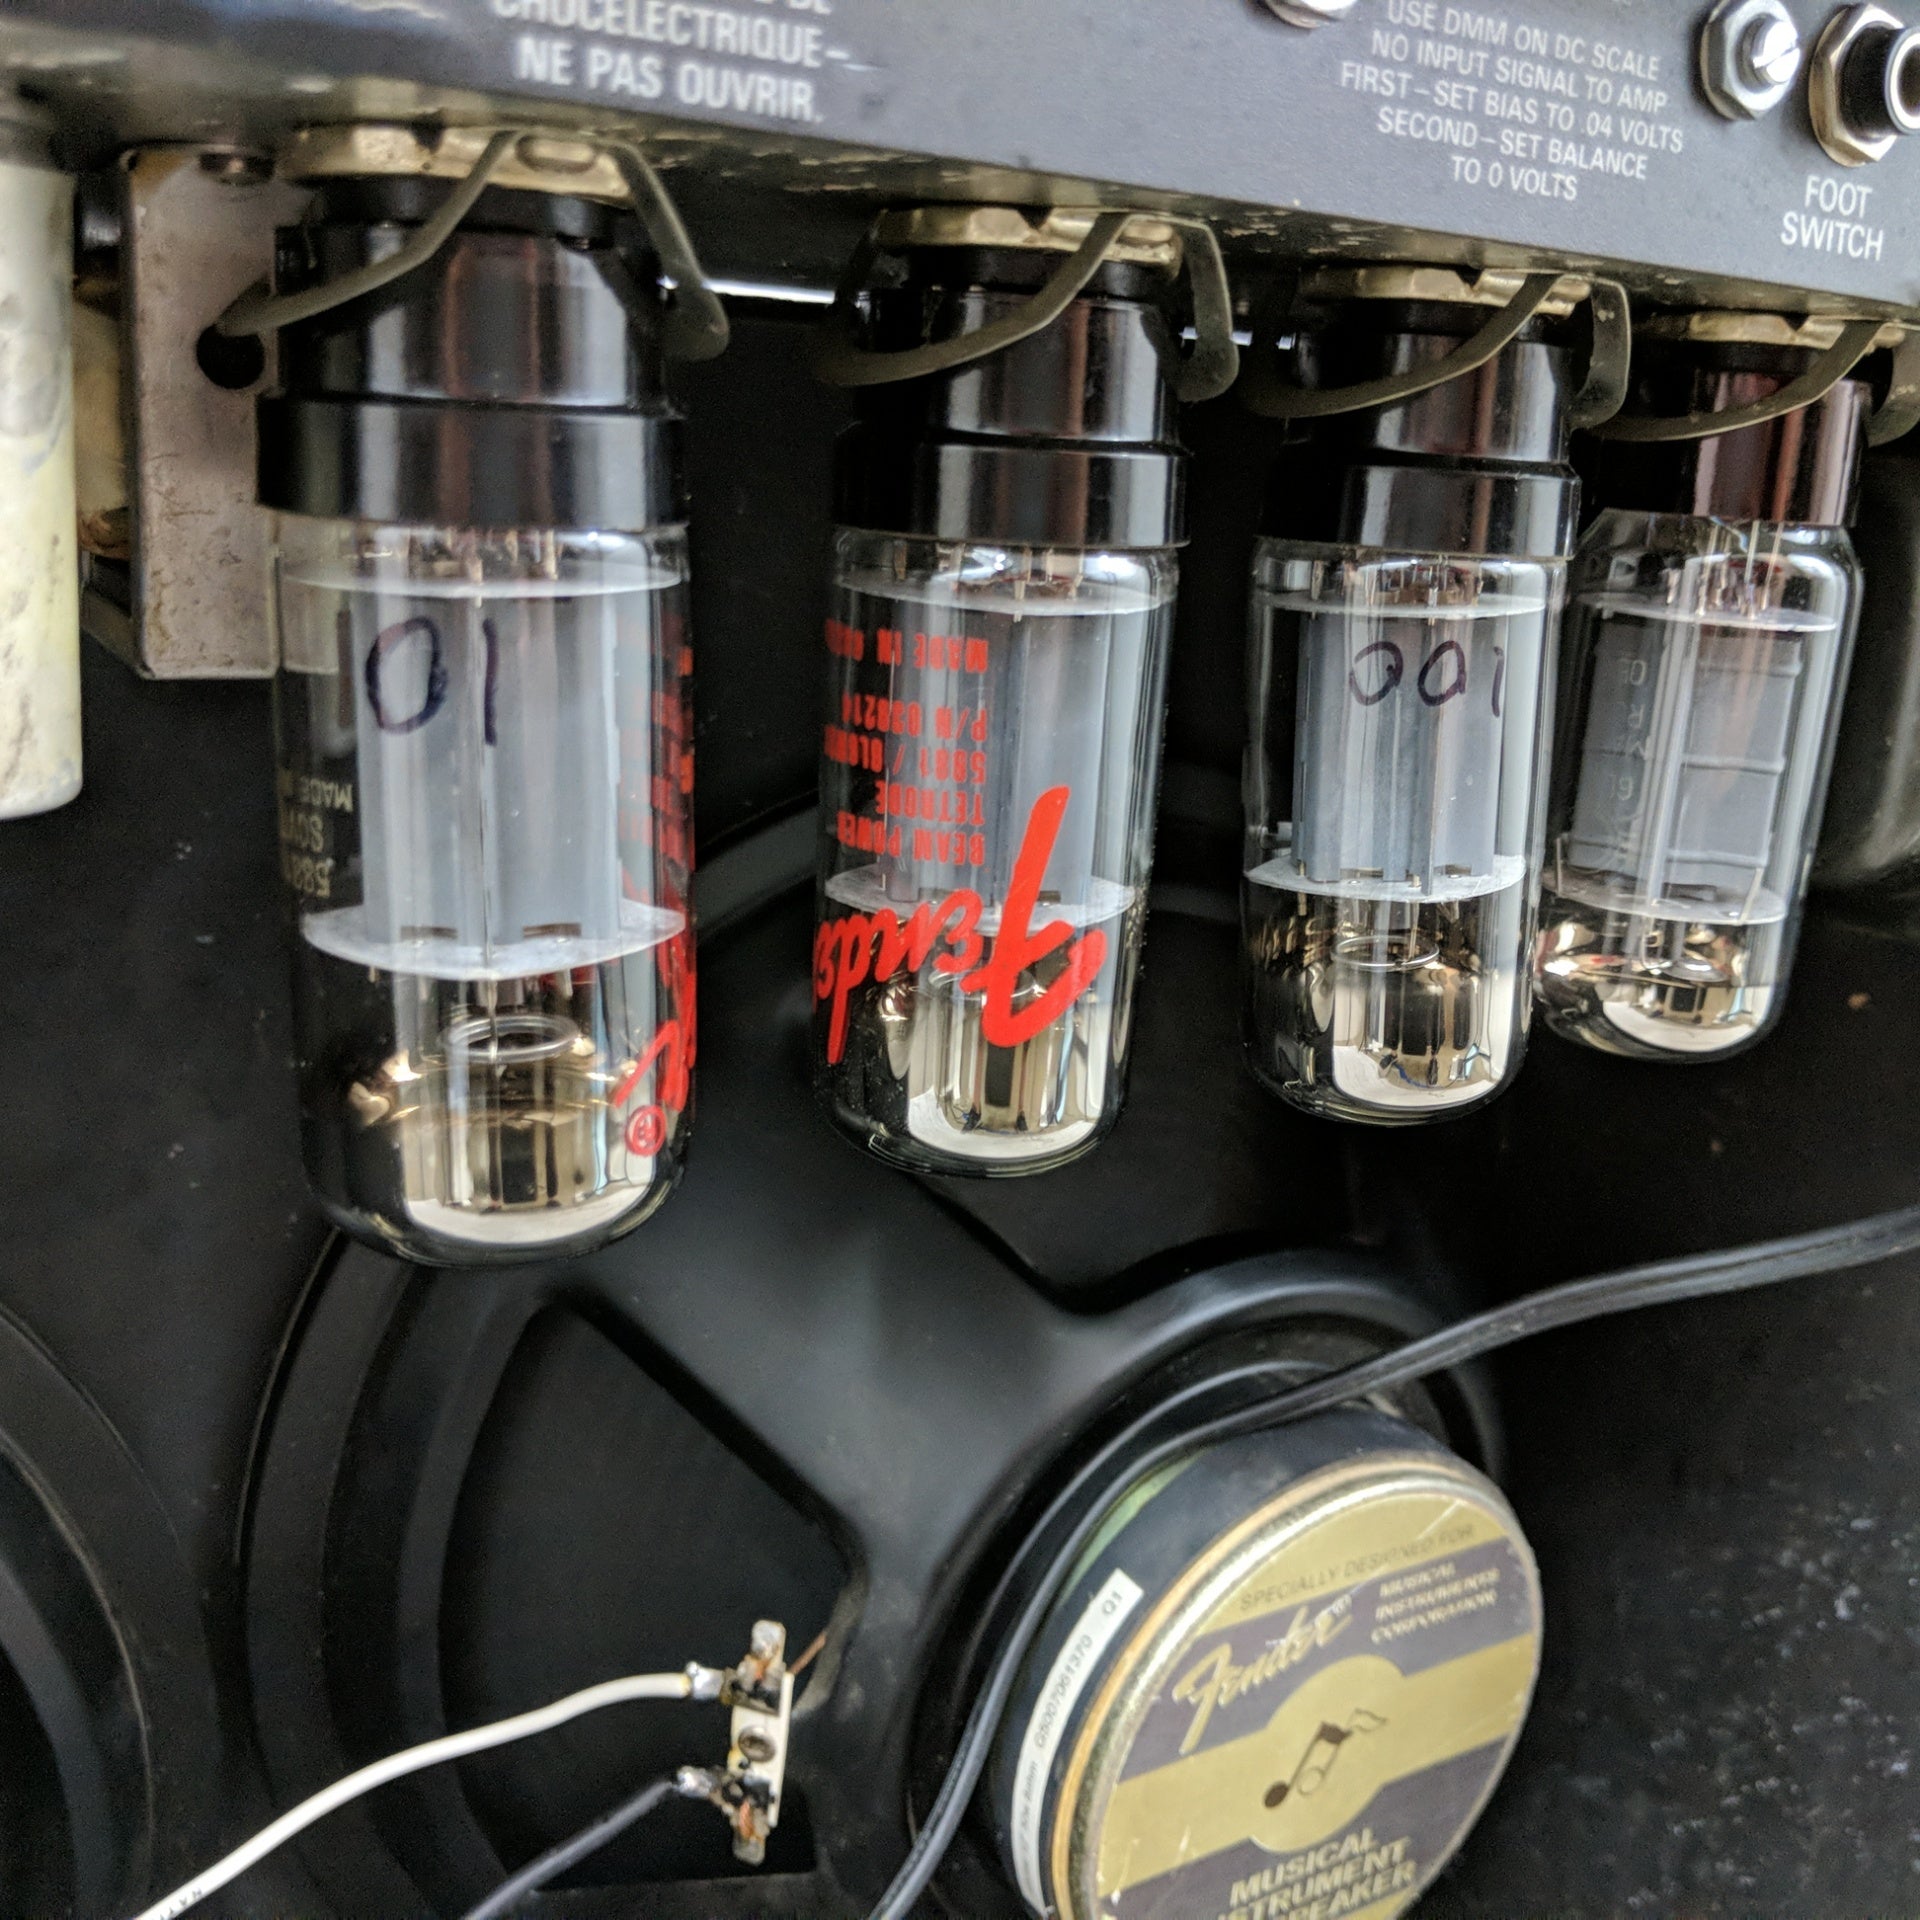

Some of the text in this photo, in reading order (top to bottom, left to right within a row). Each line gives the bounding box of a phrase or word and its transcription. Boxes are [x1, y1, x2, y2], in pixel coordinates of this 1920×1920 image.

[1388, 2, 1661, 81] USE DMM ON DC SCALE
[516, 35, 826, 124] NE PAS OUVRIR.
[1370, 29, 1669, 114] NO INPUT SIGNAL TO AMP
[1485, 87, 1539, 124] BIAS
[1547, 98, 1576, 131] TO
[1579, 107, 1612, 138] .04
[1619, 117, 1684, 155] VOLTS
[1450, 155, 1579, 202] TO 0 VOLTS
[1548, 137, 1649, 181] BALANCE
[1804, 175, 1873, 219] FOOT
[1779, 210, 1884, 262] SWITCH
[913, 633, 989, 674] MADE
[874, 779, 986, 826] TETRODE
[913, 828, 986, 866] BEAM
[1229, 1828, 1376, 1907] MUSICAL
